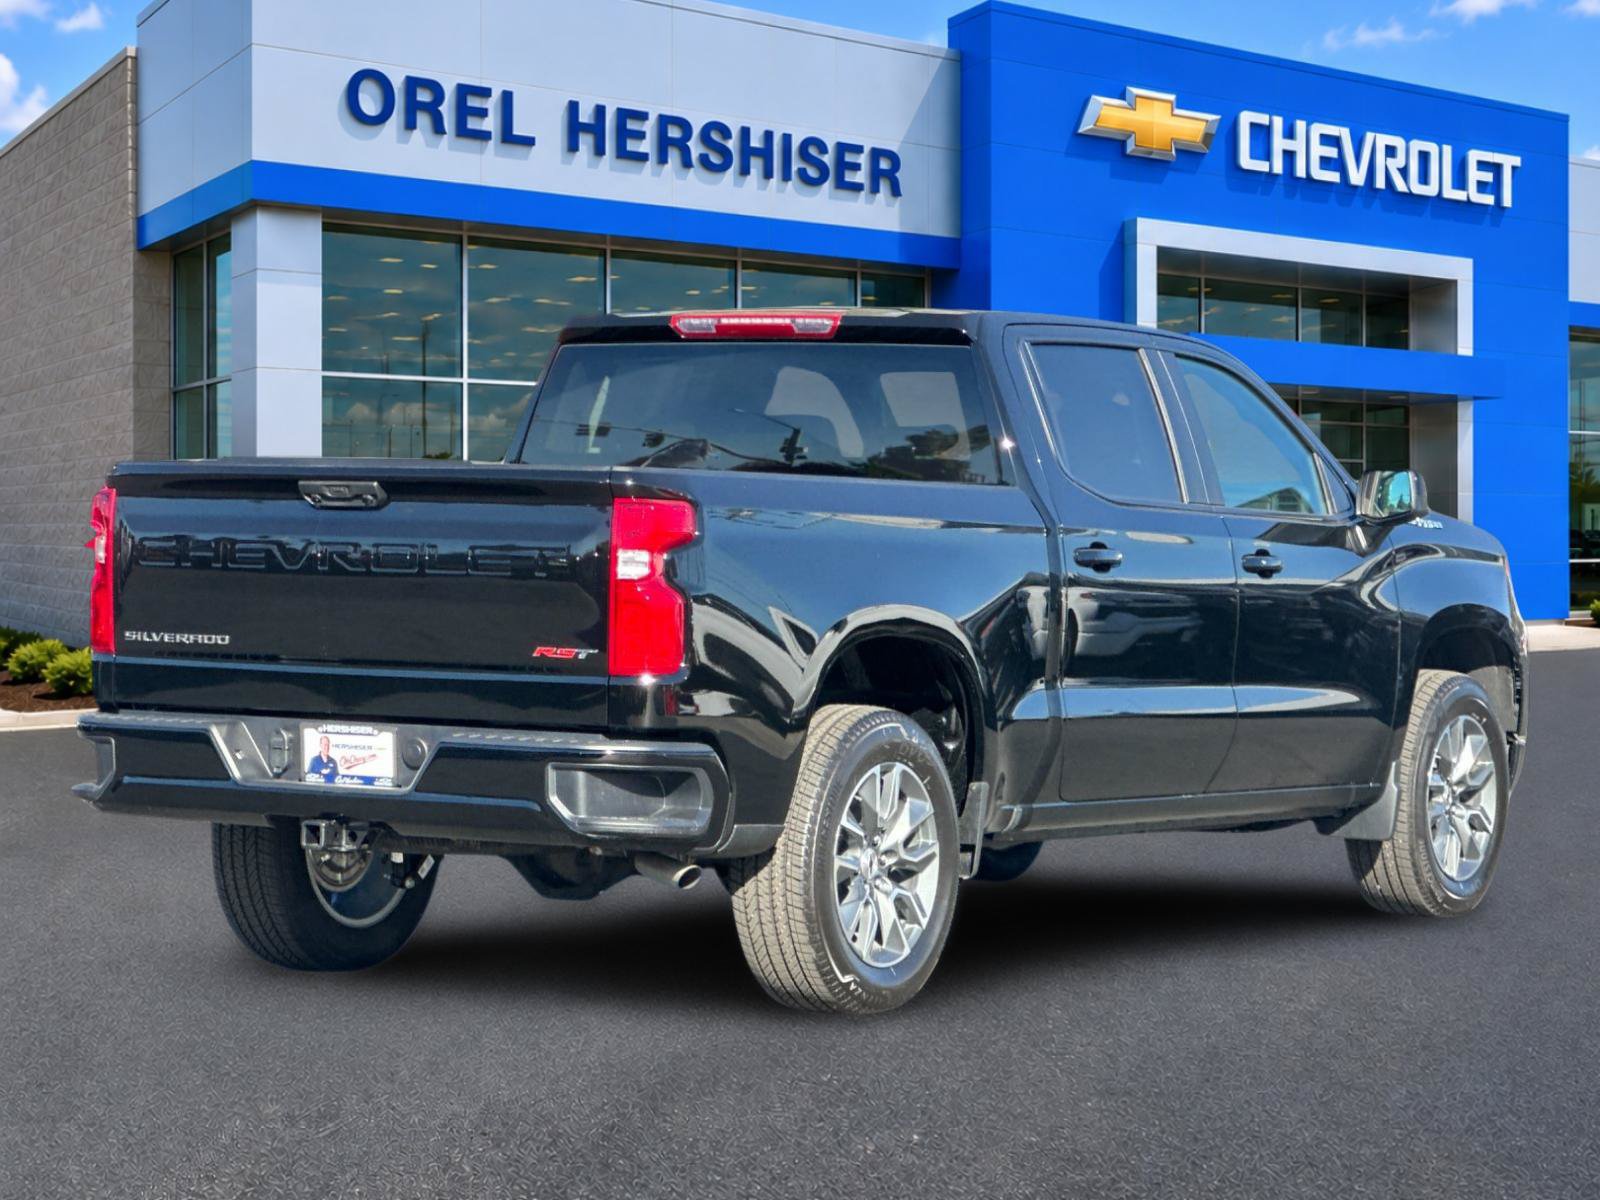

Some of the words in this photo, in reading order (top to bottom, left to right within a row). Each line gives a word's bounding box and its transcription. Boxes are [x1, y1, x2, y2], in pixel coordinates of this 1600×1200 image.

[346, 68, 536, 147] OREL
[567, 99, 902, 198] HERSHISER
[1237, 110, 1522, 208] CHEVROLET
[138, 535, 571, 577] CHEVROLET
[124, 630, 231, 645] SILVERADO
[532, 646, 600, 660] RST
